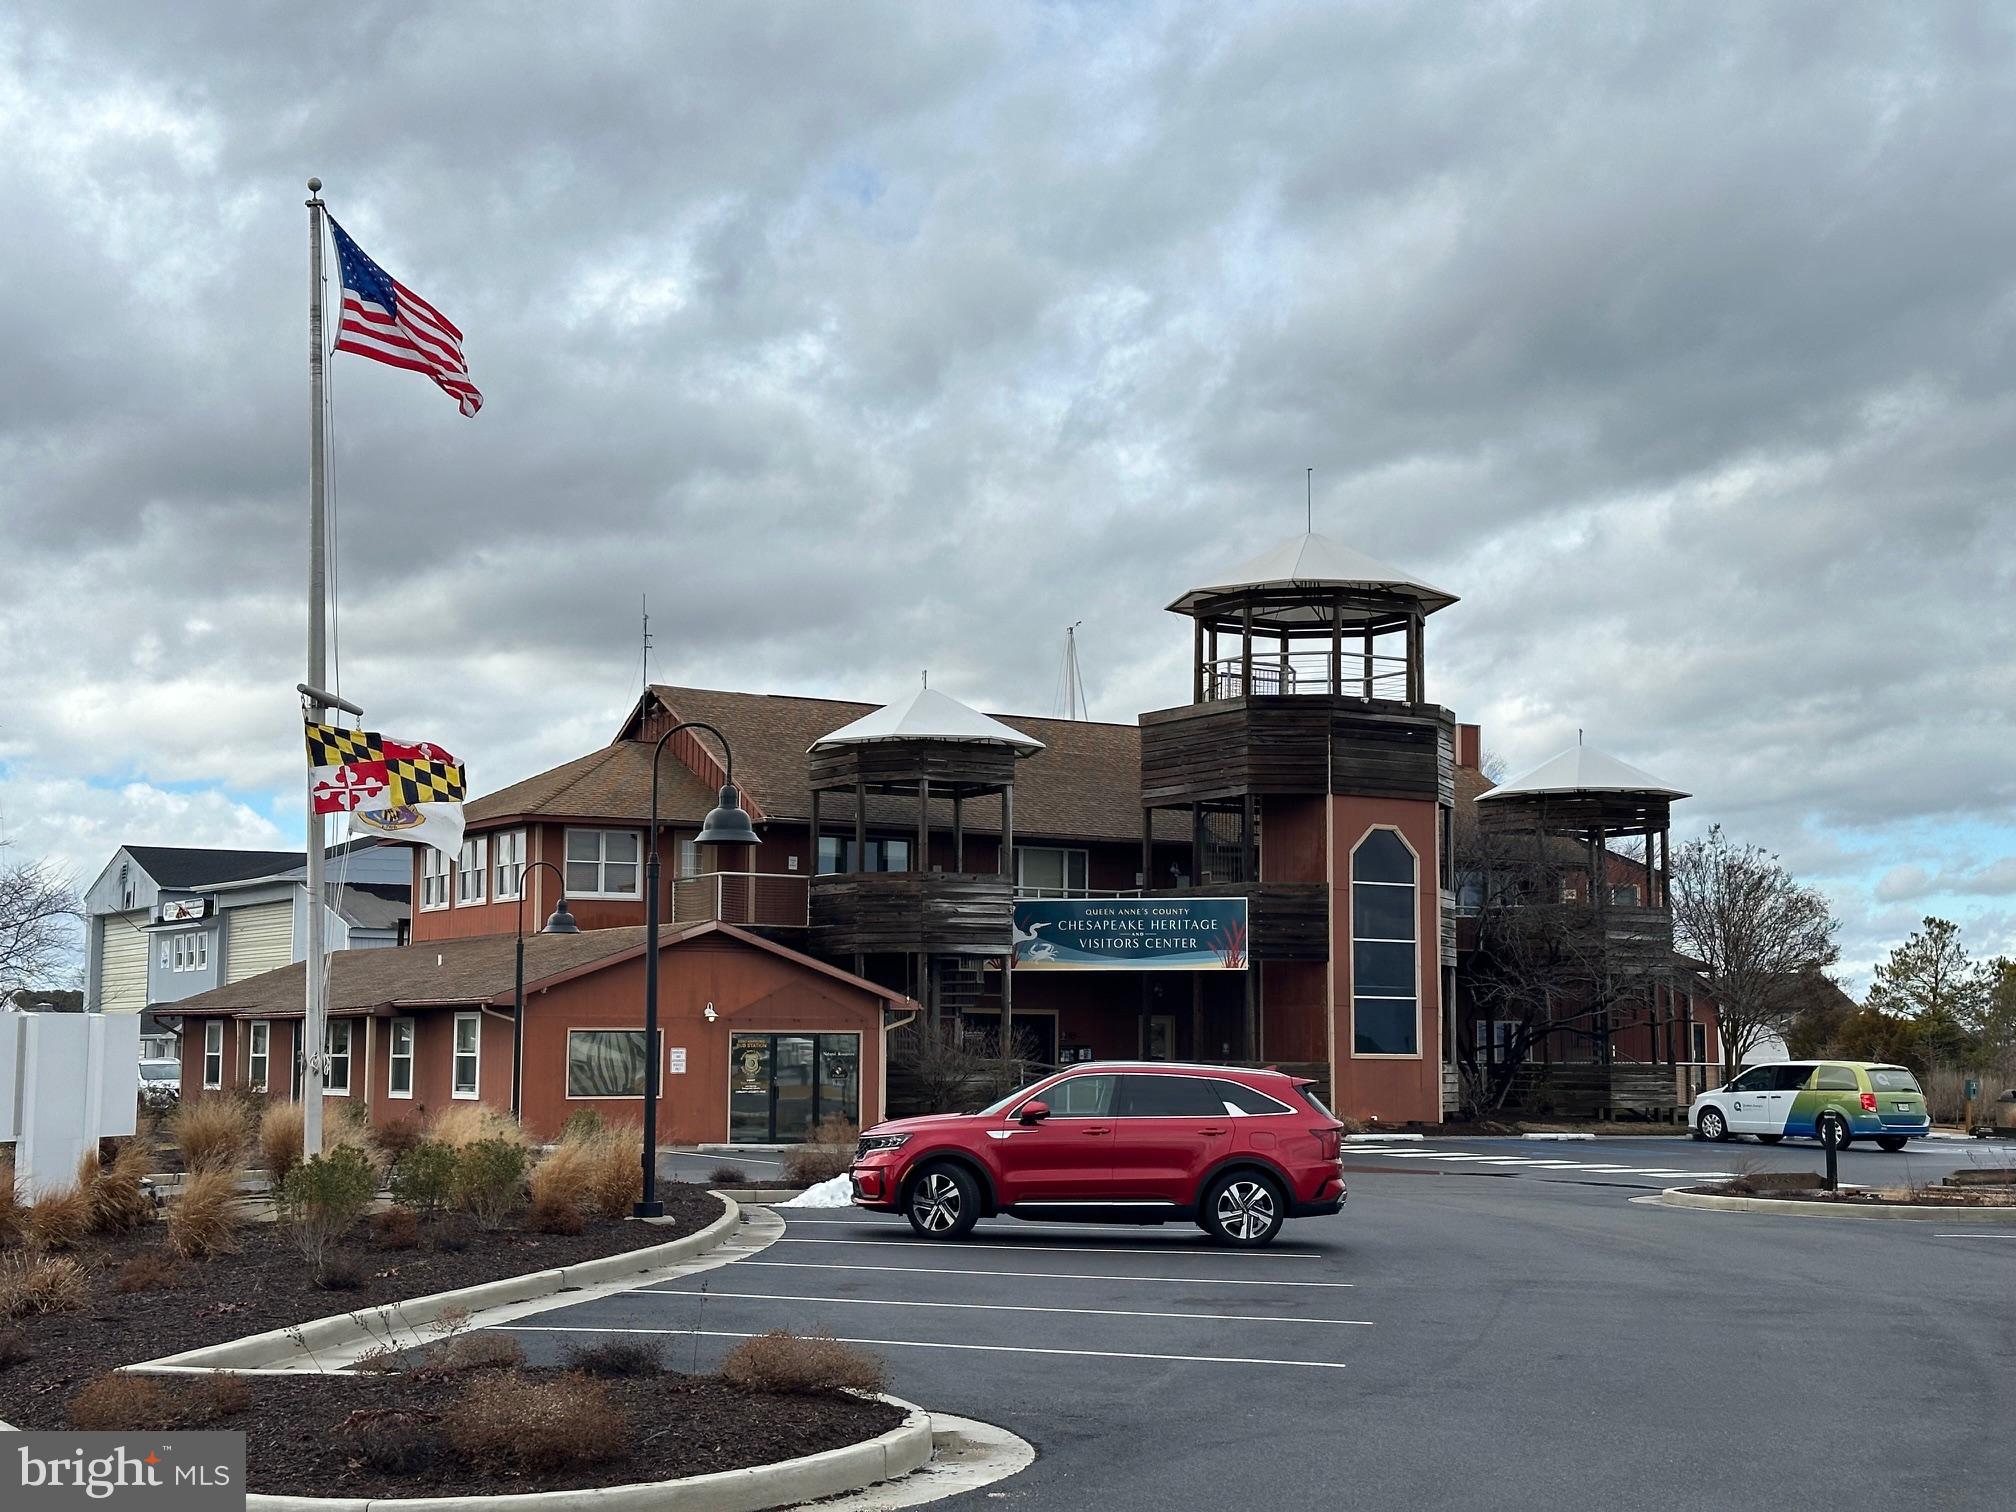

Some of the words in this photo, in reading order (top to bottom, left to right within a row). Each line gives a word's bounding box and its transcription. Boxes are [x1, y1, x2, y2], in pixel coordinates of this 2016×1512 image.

[1085, 908, 1115, 916] QUEEN
[1118, 907, 1149, 915] ANNE'S
[1152, 908, 1190, 916] COUNTY
[1058, 919, 1145, 931] CHESAPEAKE
[1151, 919, 1218, 930] HERITAGE
[1079, 938, 1140, 949] VISITORS
[1145, 938, 1197, 949] CENTER
